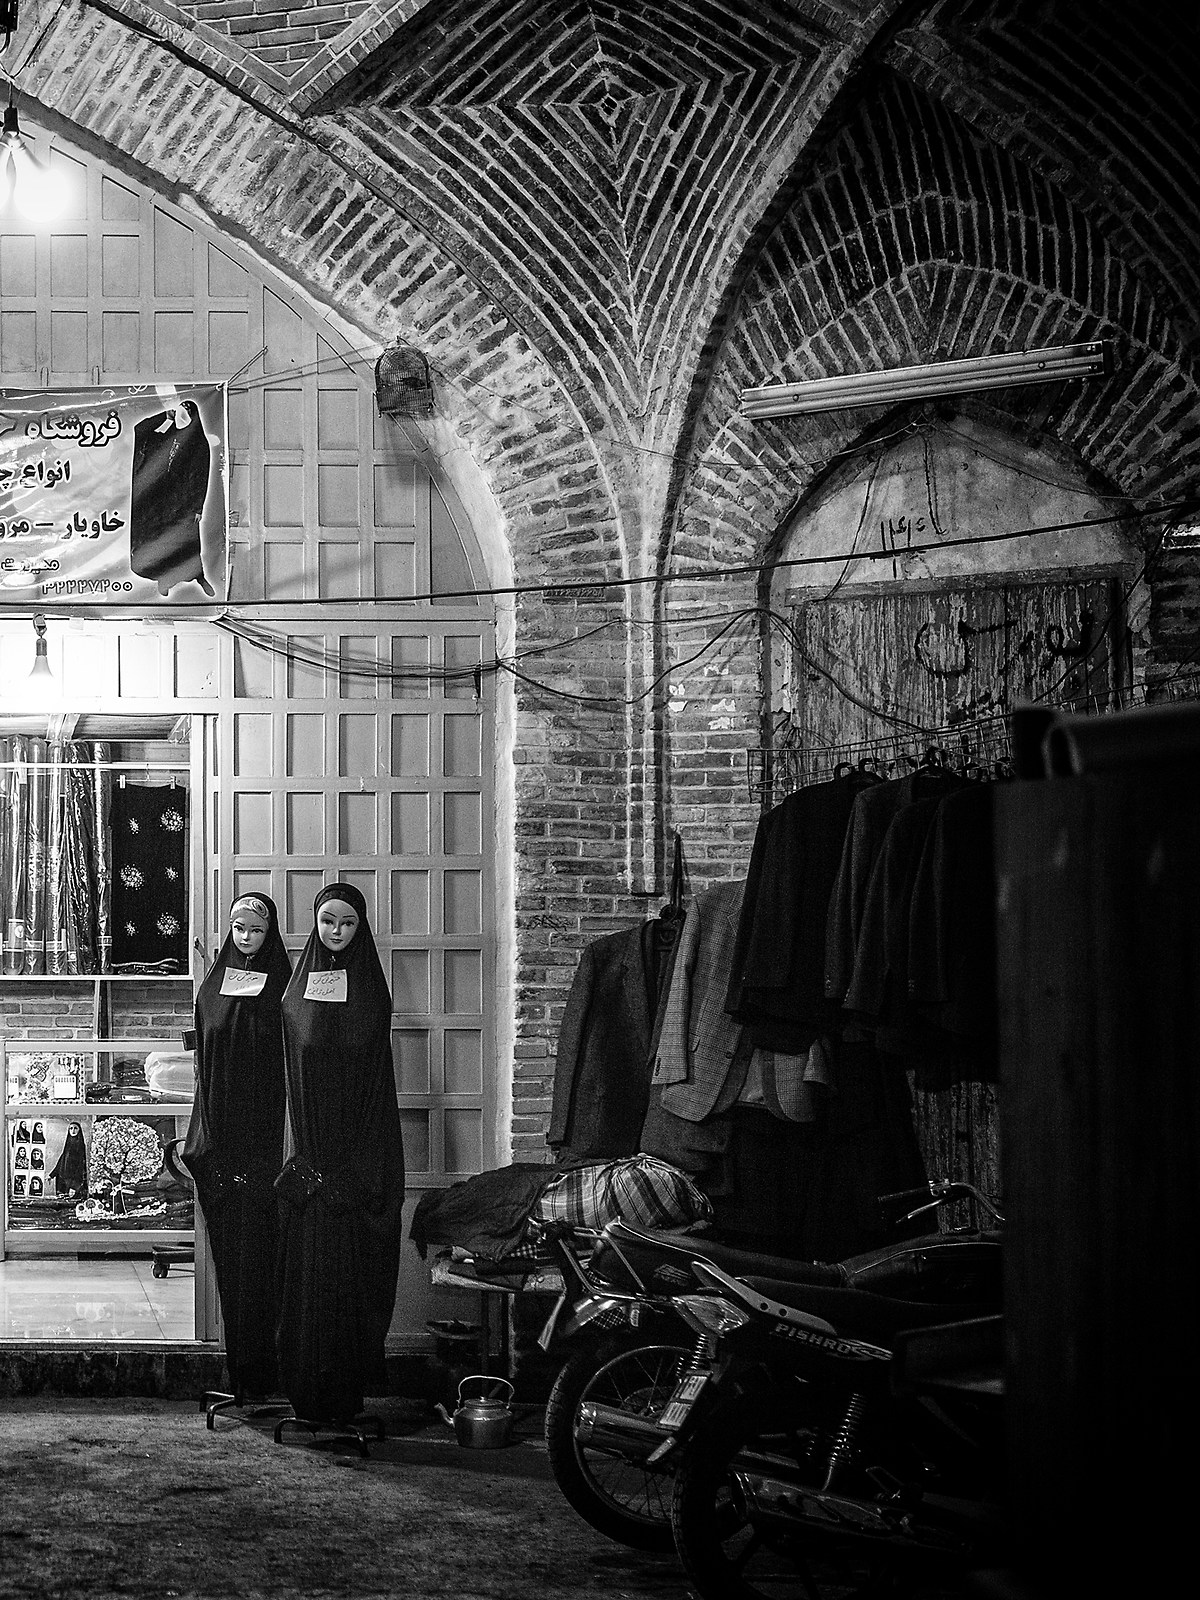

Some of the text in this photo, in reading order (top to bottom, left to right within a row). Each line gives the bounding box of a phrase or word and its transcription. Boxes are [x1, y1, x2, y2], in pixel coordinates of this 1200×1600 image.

[26, 409, 122, 446] فروشگاه
[20, 460, 71, 489] انواع
[61, 510, 126, 539] خاویار
[775, 1323, 852, 1354] PISHRO
